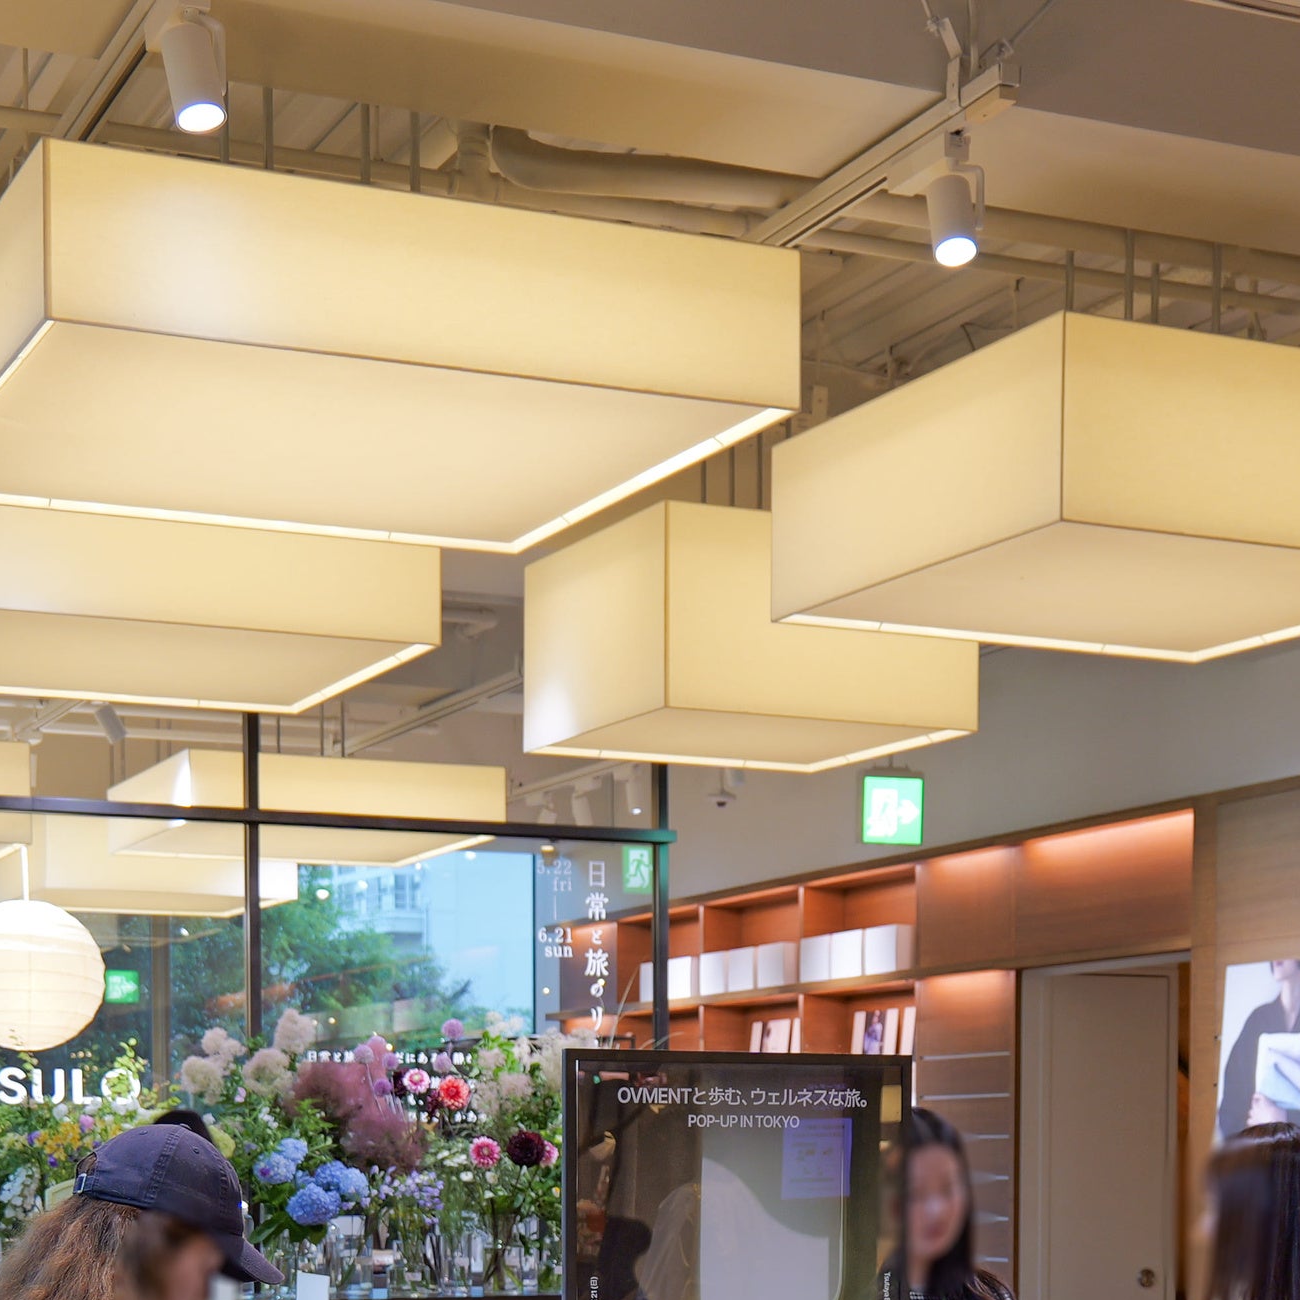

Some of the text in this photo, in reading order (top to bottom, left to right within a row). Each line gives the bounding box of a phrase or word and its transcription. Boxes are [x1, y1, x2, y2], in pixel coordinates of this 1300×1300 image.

[537, 860, 572, 875] 5.22
[553, 877, 572, 892] fri
[538, 927, 573, 943] 6.21
[544, 944, 573, 958] sun
[584, 861, 609, 1047] 日常と旅のリ
[617, 1086, 868, 1109] OVMENTと歩む、ウェルネスな旅。
[687, 1114, 800, 1129] POP-UP IN TOKYO
[591, 1290, 598, 1299] 21
